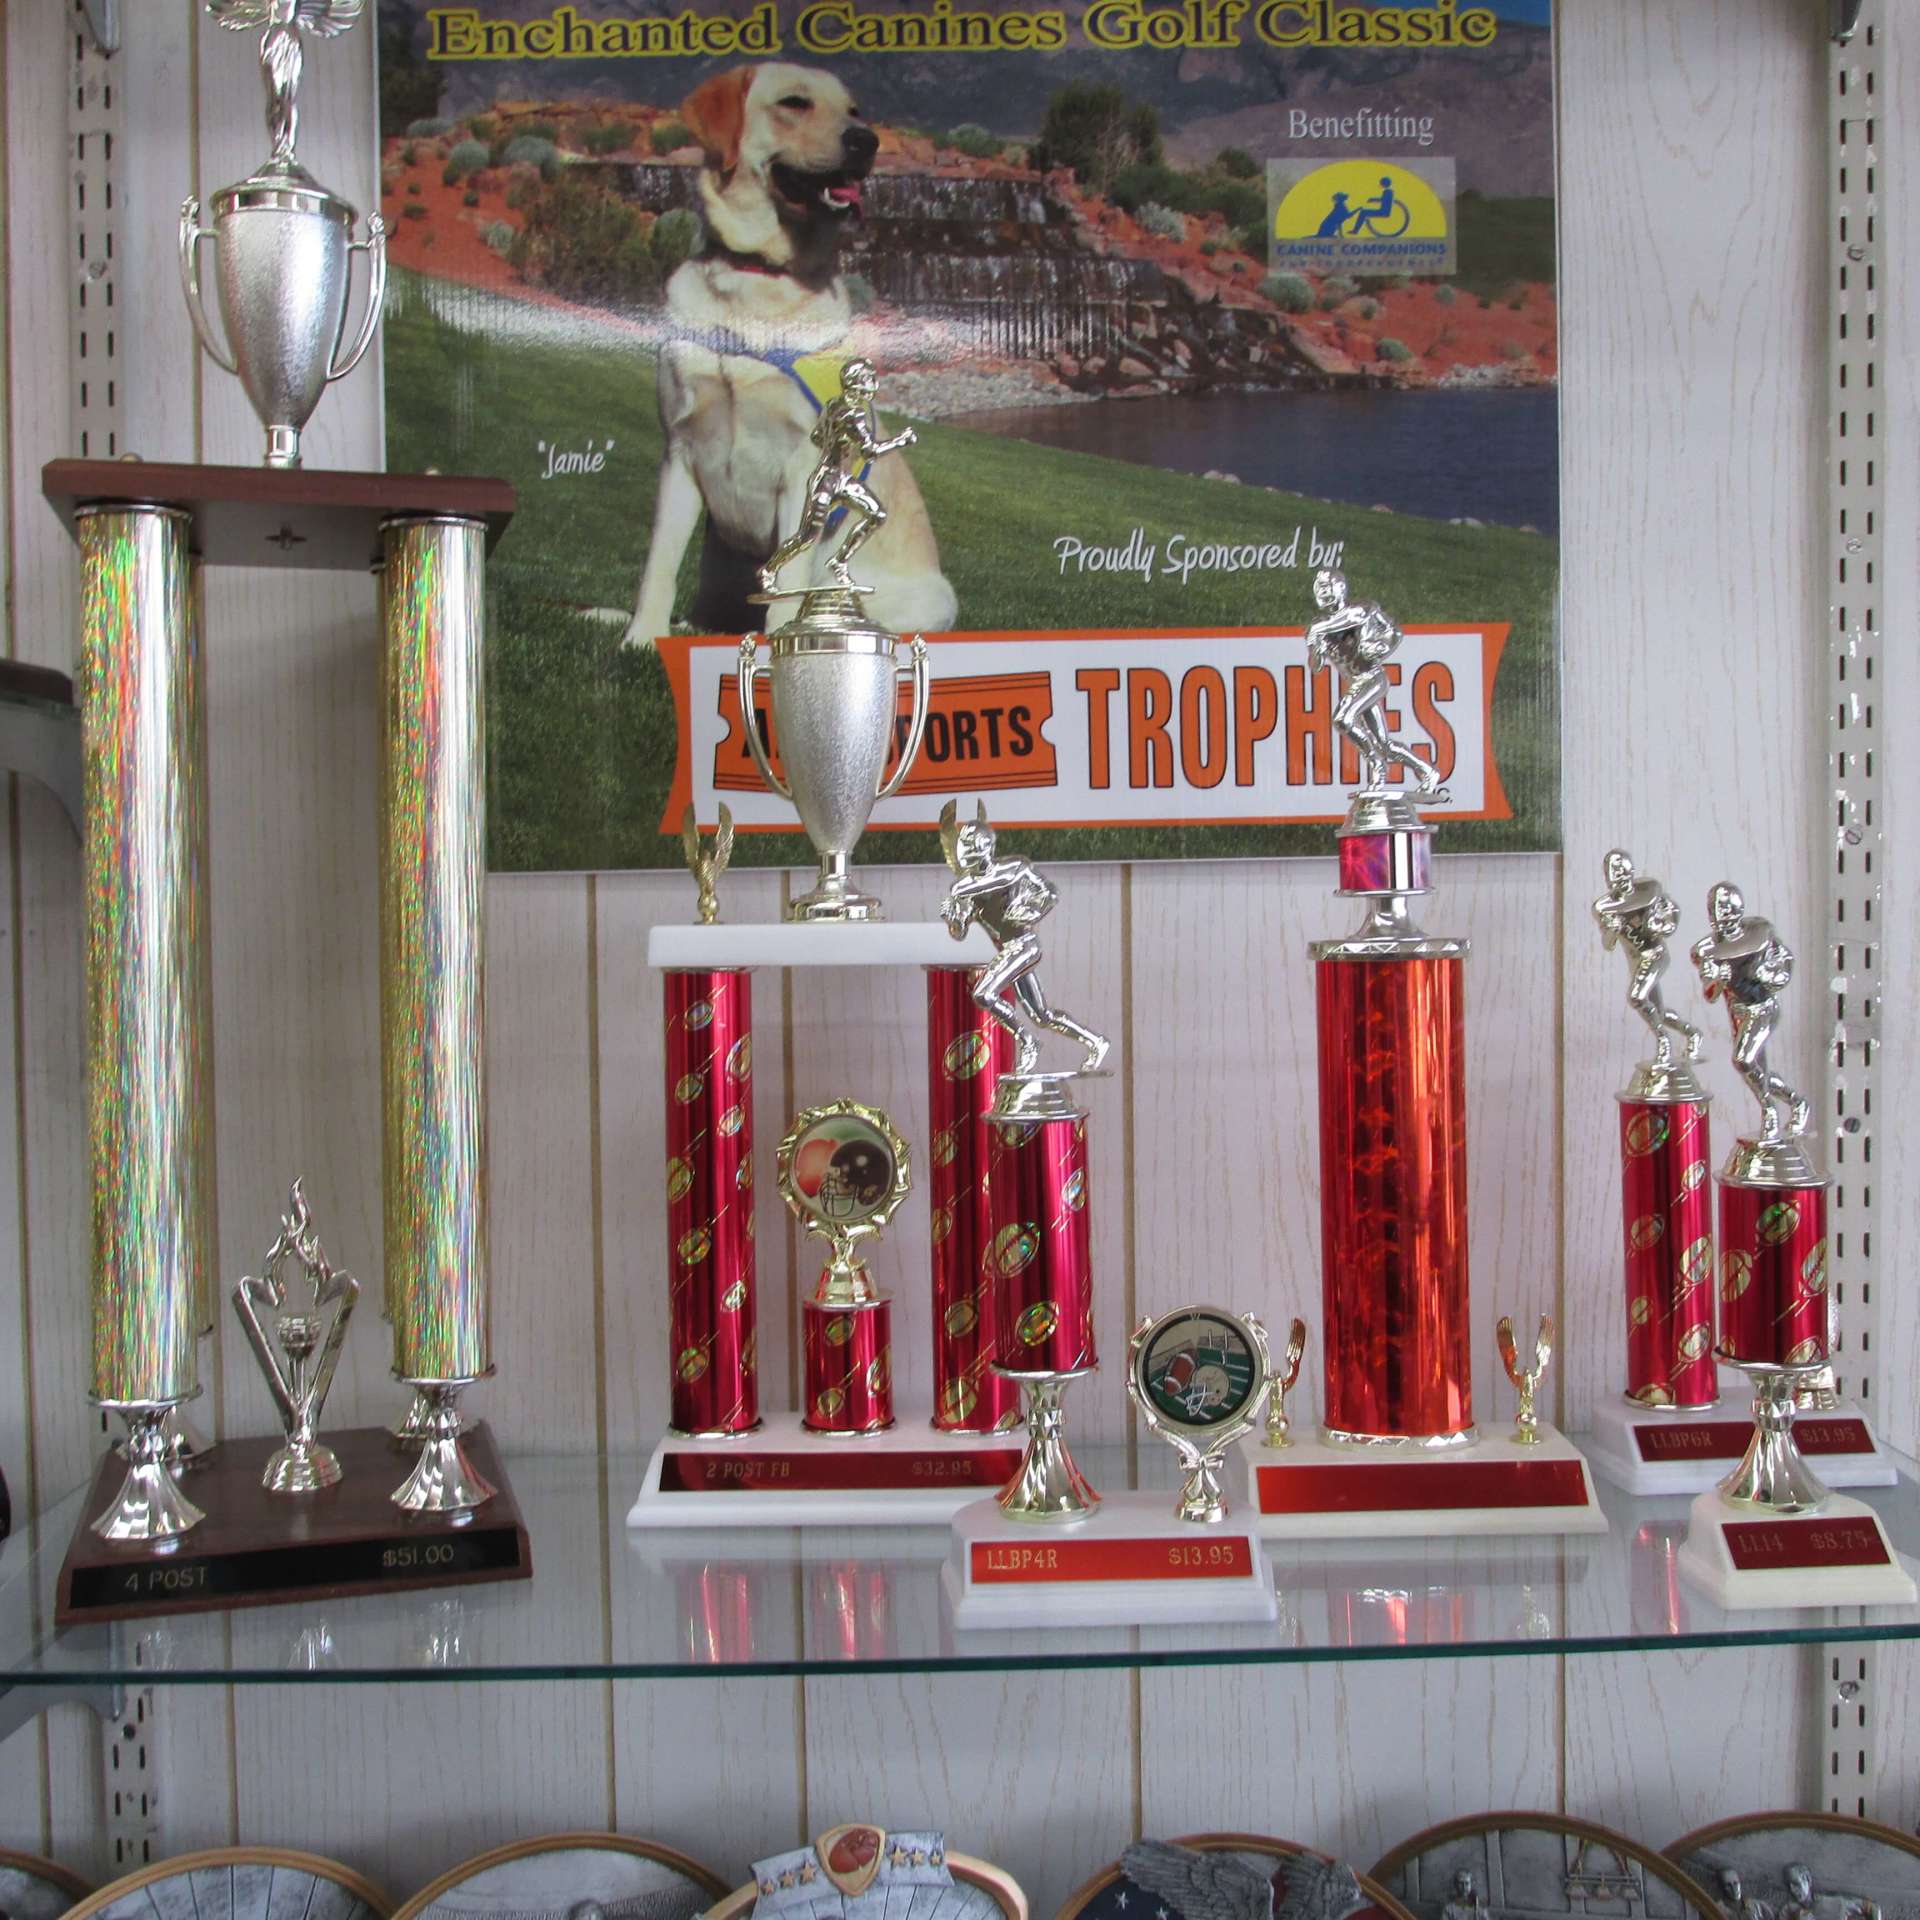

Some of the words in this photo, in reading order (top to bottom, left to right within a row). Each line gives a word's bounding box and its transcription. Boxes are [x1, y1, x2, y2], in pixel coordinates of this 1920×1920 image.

[431, 4, 778, 58] Enchanted
[799, 1, 1064, 51] Canines
[1085, 0, 1247, 48] Golf
[1256, 0, 1496, 48] Classic
[1288, 107, 1435, 146] Benefitting
[1277, 242, 1333, 256] CANINE
[1341, 242, 1447, 256] COMPANIONS
[1053, 526, 1156, 583] Proudly
[1161, 526, 1302, 585] Sponsored
[887, 705, 1034, 766] PORTS
[705, 1463, 718, 1479] 2
[723, 1462, 766, 1478] POST
[770, 1462, 791, 1478] FB
[124, 1573, 139, 1593] 4
[149, 1566, 209, 1591] POST
[382, 1543, 455, 1567] $51.00
[986, 1548, 1058, 1570] LLBP4R
[1167, 1545, 1234, 1566] $13.95
